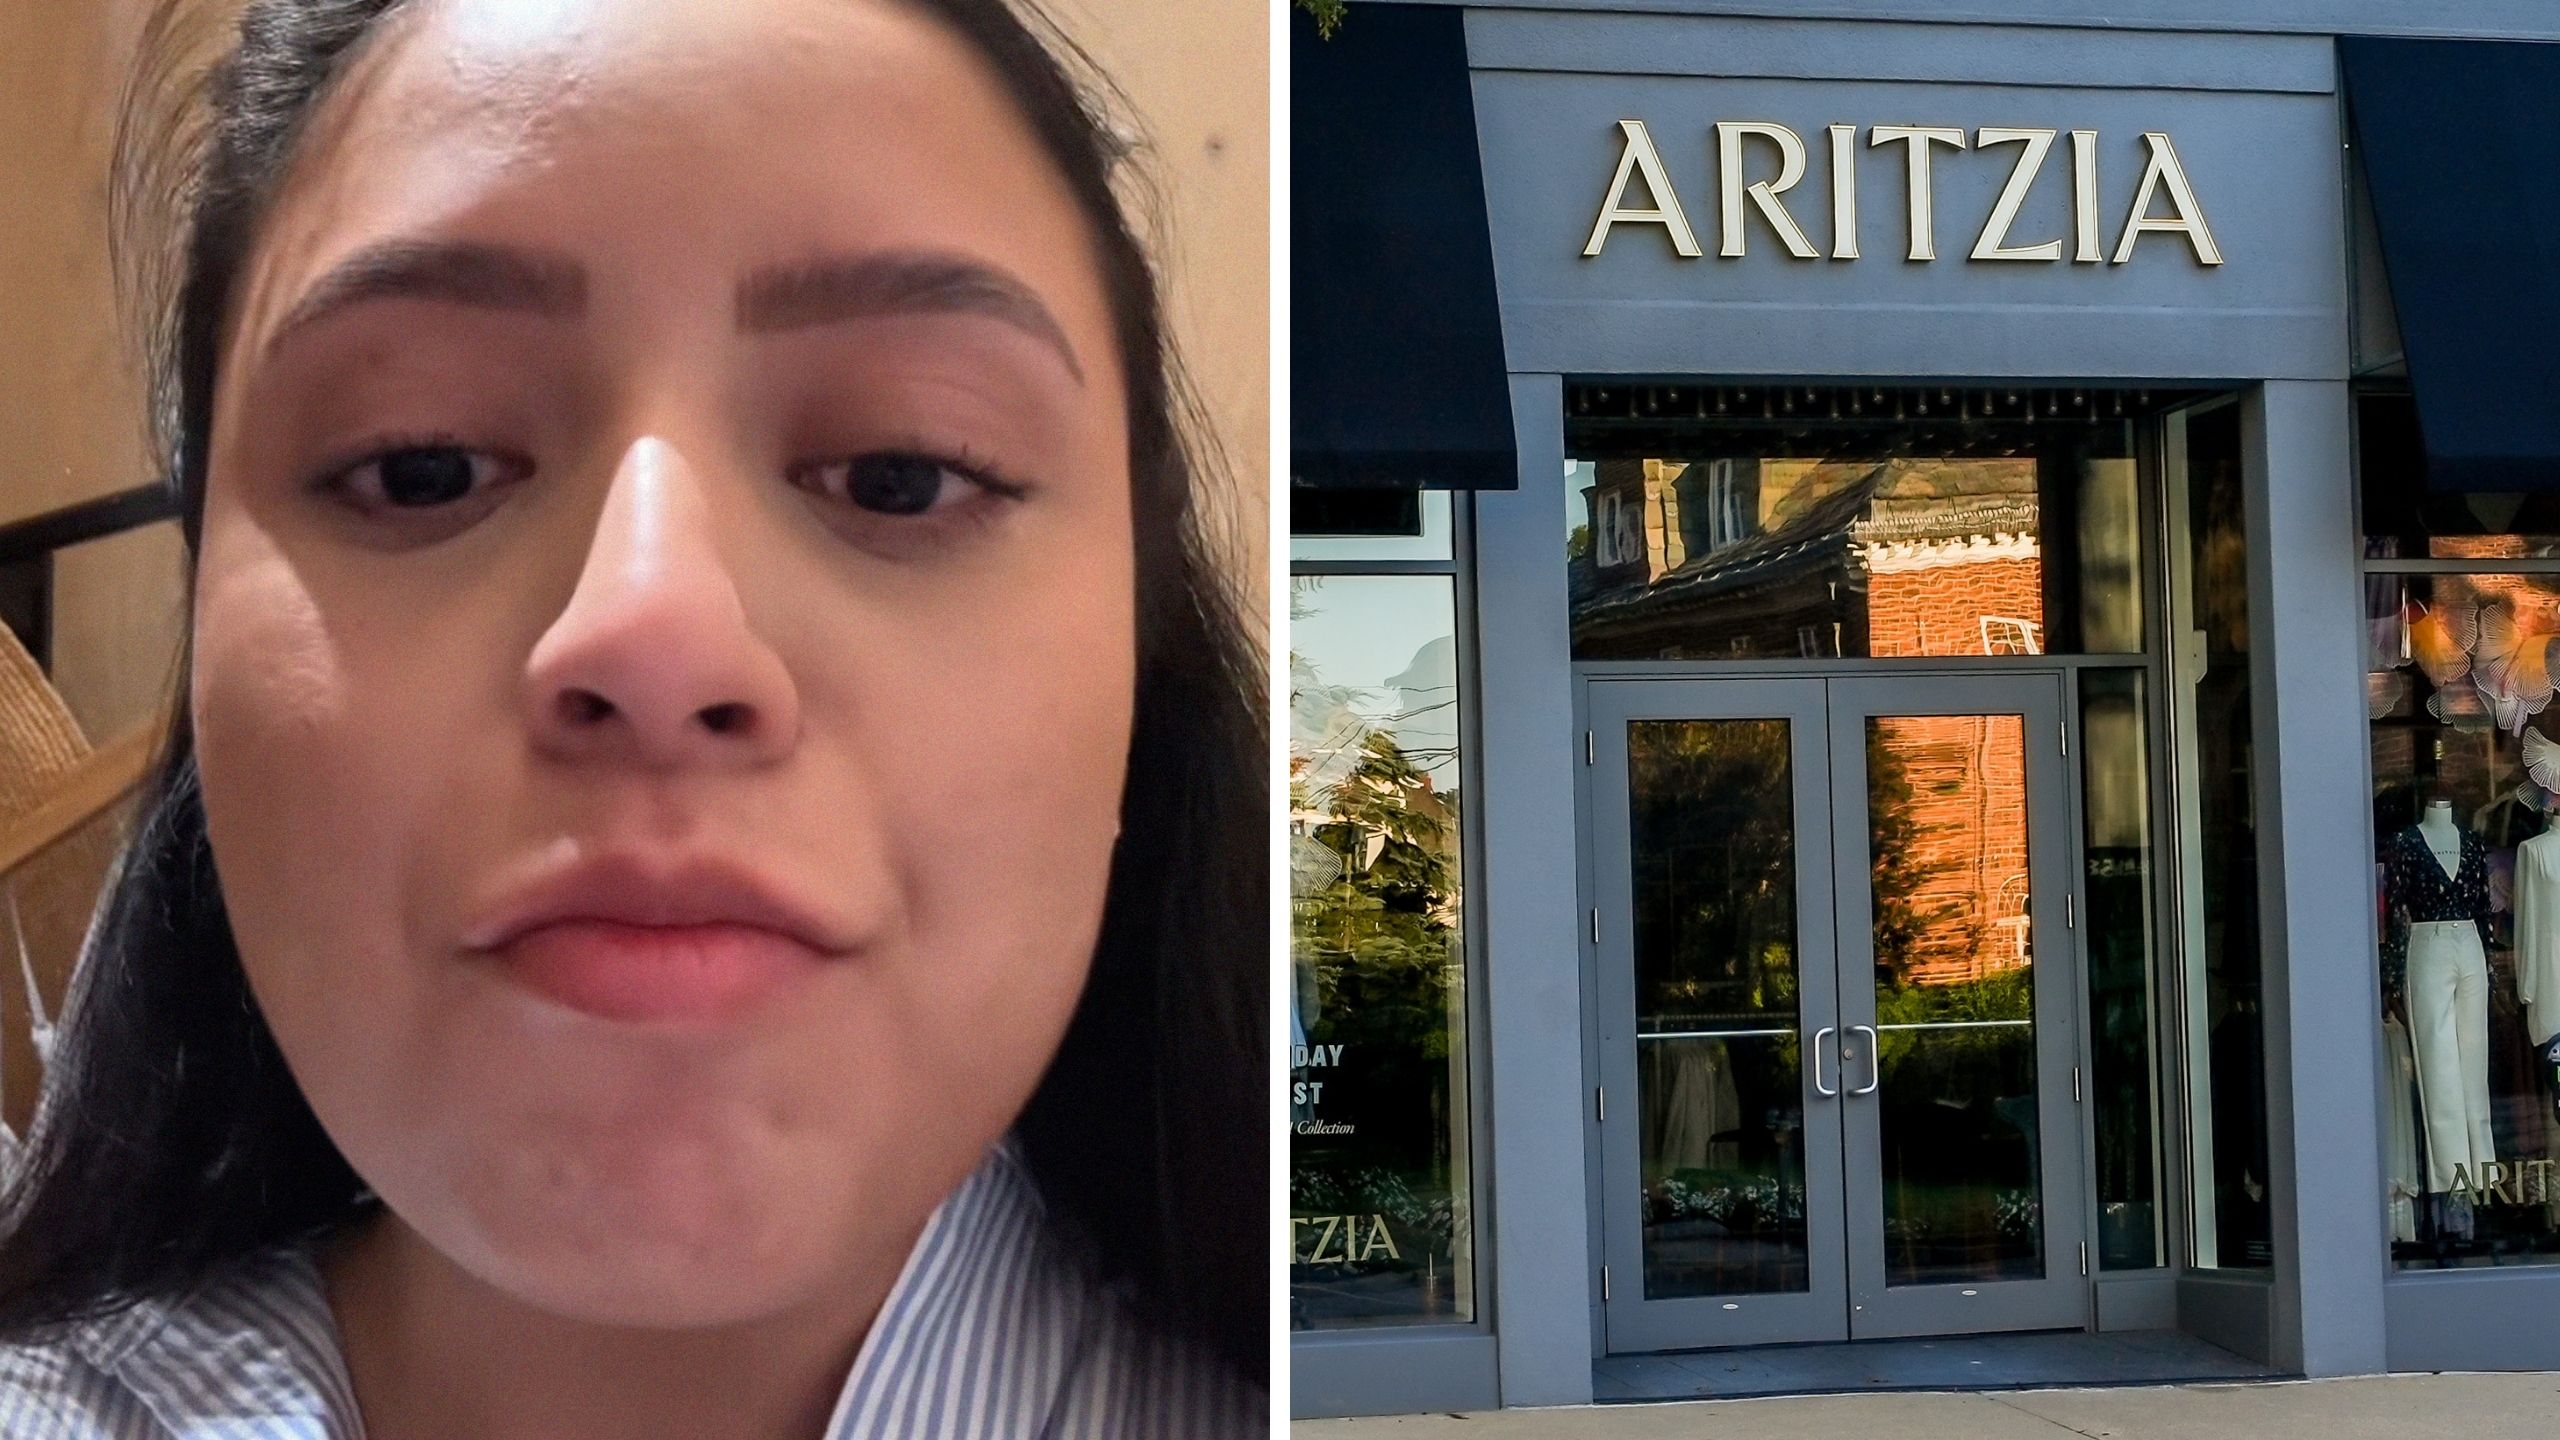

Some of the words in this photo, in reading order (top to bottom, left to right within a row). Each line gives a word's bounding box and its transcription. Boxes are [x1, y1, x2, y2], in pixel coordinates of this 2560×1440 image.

[1581, 118, 2224, 266] ARITZIA
[1293, 1081, 1323, 1105] ST
[1297, 1119, 1355, 1135] Collection
[2447, 1159, 2556, 1206] ARIT
